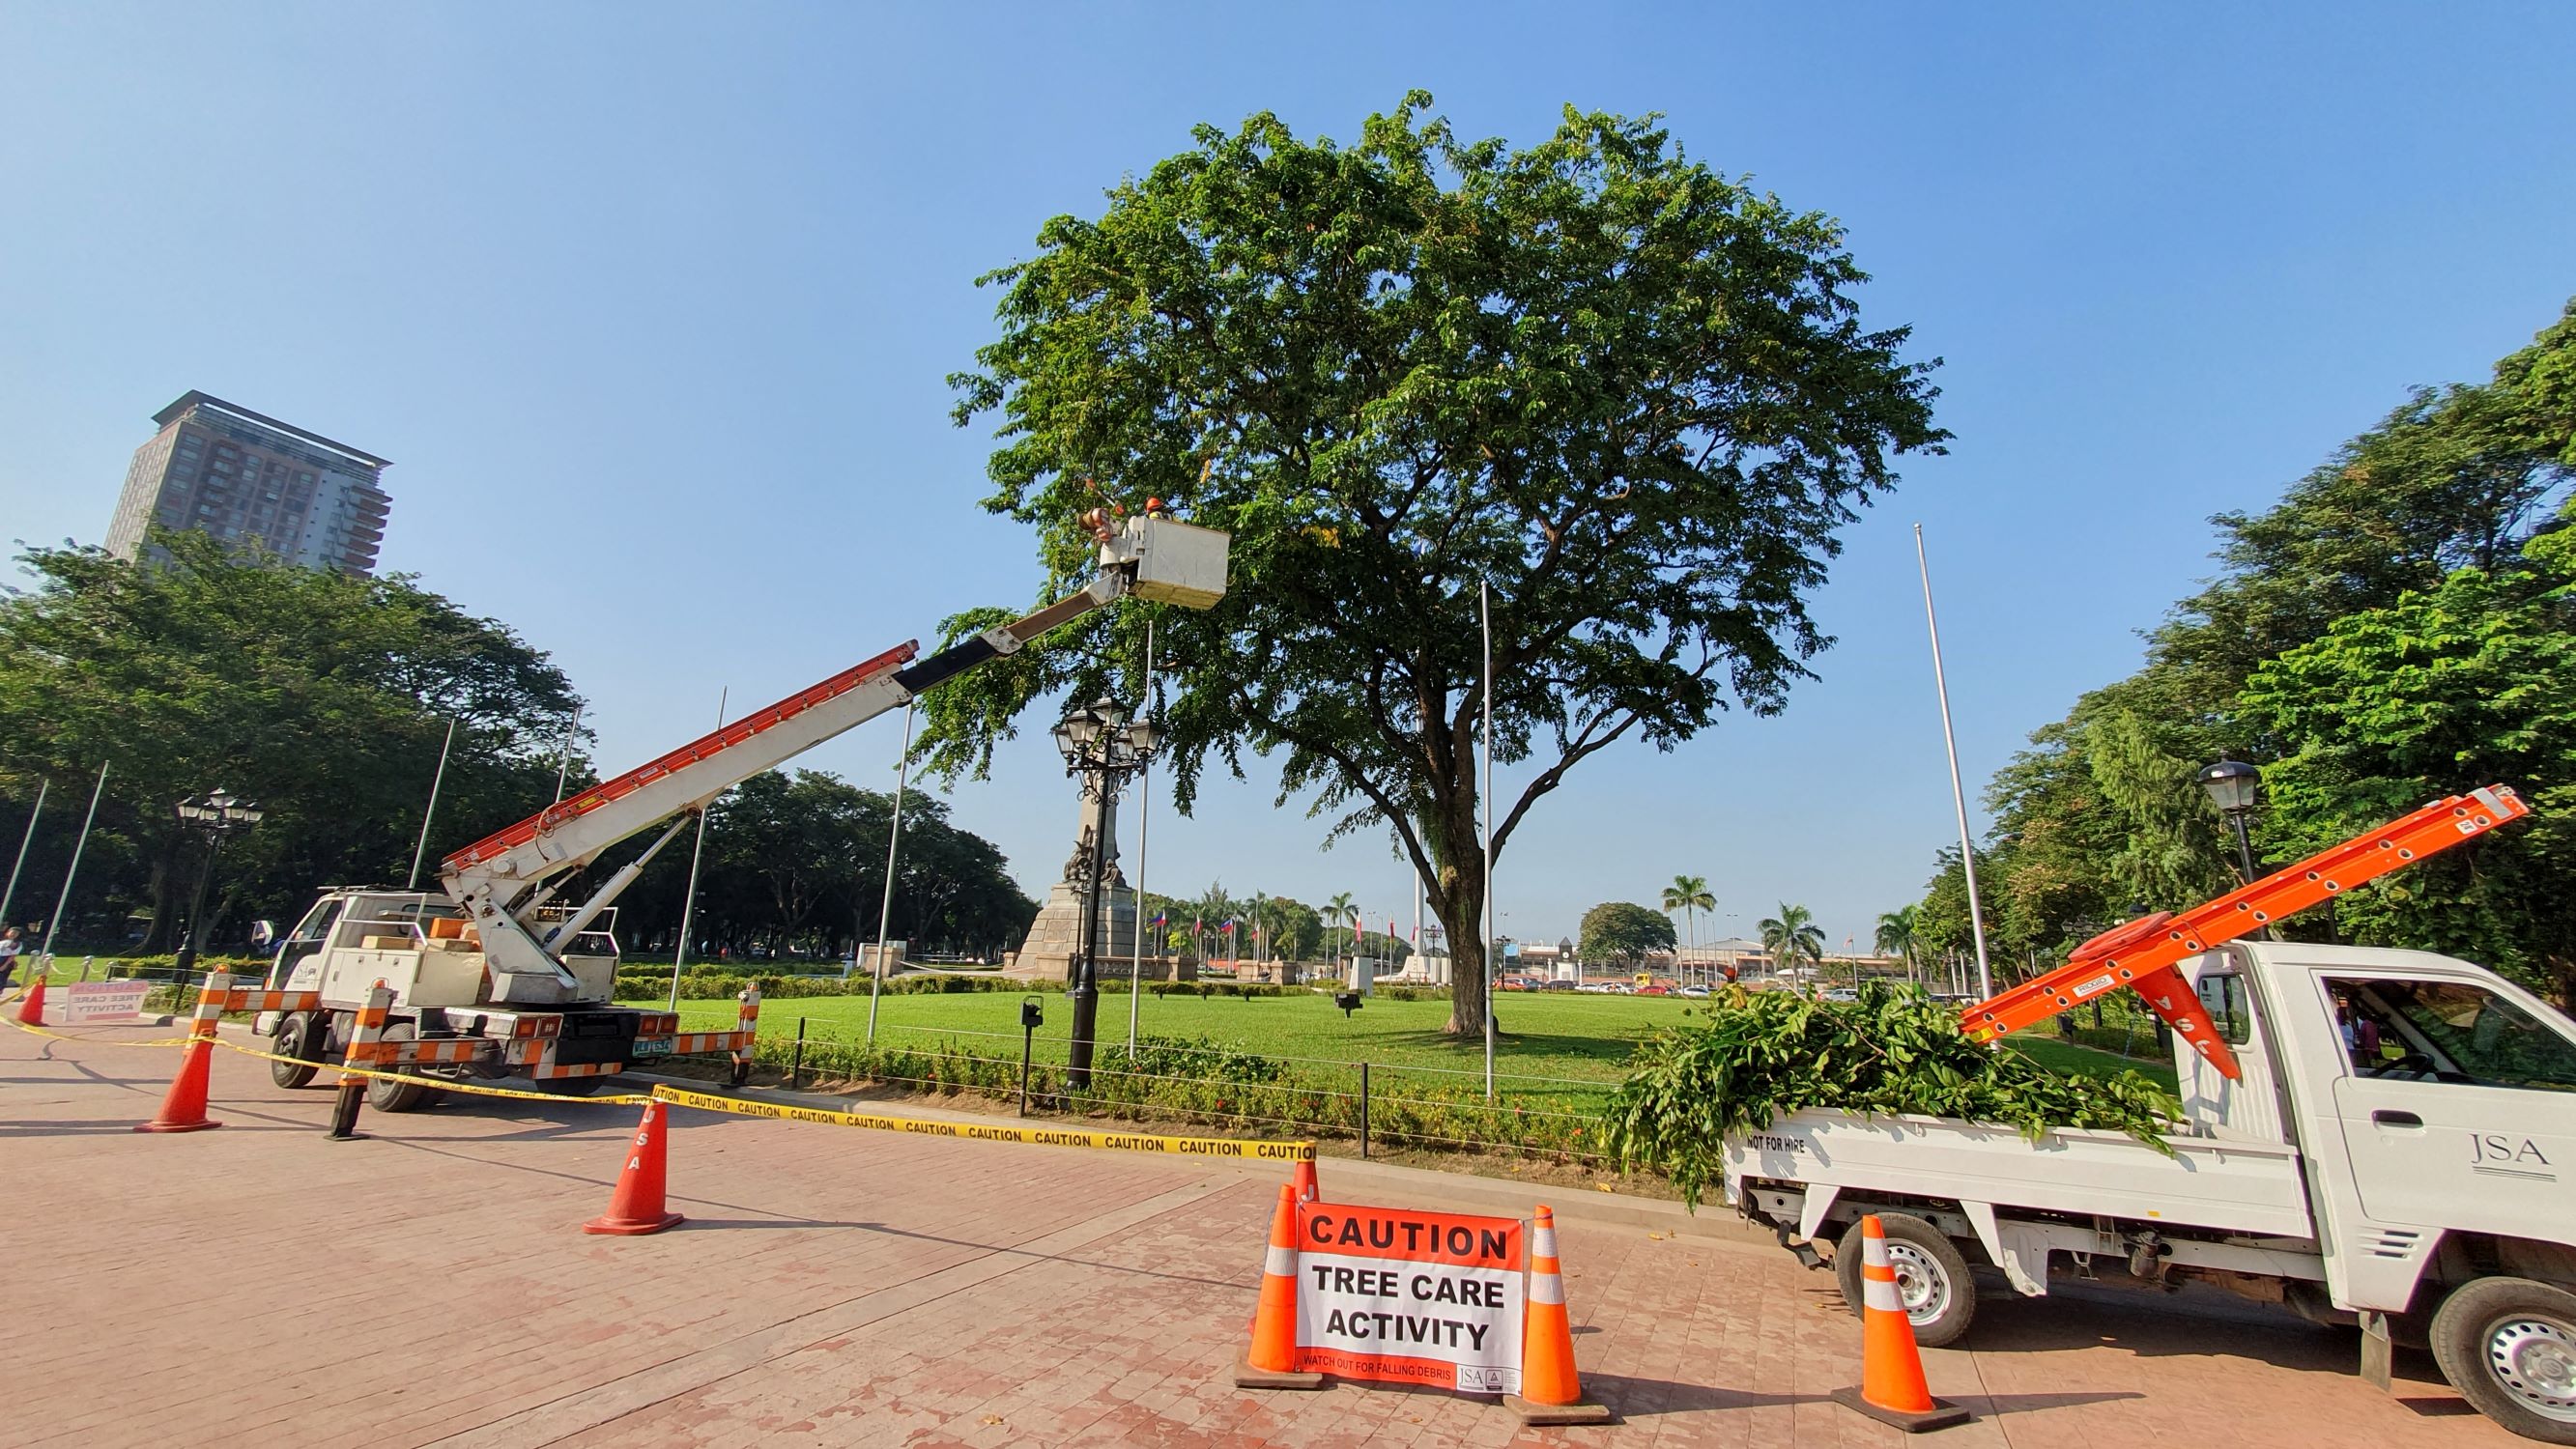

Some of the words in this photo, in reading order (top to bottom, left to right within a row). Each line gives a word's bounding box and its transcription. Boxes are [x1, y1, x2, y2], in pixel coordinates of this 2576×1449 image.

[654, 1087, 679, 1102] UTION
[689, 1095, 729, 1110] CAUTION
[738, 1103, 781, 1118] CAUTION
[790, 1110, 836, 1124] CAUTION
[846, 1116, 895, 1130] CAUTION
[906, 1122, 957, 1136] CAUTION
[968, 1127, 1022, 1142] CAUTION
[1035, 1132, 1091, 1147] CAUTION
[1105, 1136, 1164, 1151] CAUTION
[1180, 1141, 1242, 1155] CAUTION
[1747, 1134, 1763, 1150] NOT
[1766, 1136, 1783, 1151] FOR
[1785, 1137, 1805, 1153] HIRE
[2469, 1133, 2552, 1165] JSA
[1310, 1215, 1506, 1260] CAUTION
[1312, 1264, 1399, 1297] TREE
[1411, 1274, 1504, 1309] CARE
[1326, 1309, 1489, 1351] ACTIVITY
[1304, 1354, 1335, 1367] WATCH
[1338, 1357, 1352, 1370] OUT
[1356, 1361, 1374, 1374] FOR
[1377, 1362, 1415, 1376] FALLING
[1417, 1366, 1451, 1380] DEBRIS
[1459, 1368, 1483, 1385] JSA
